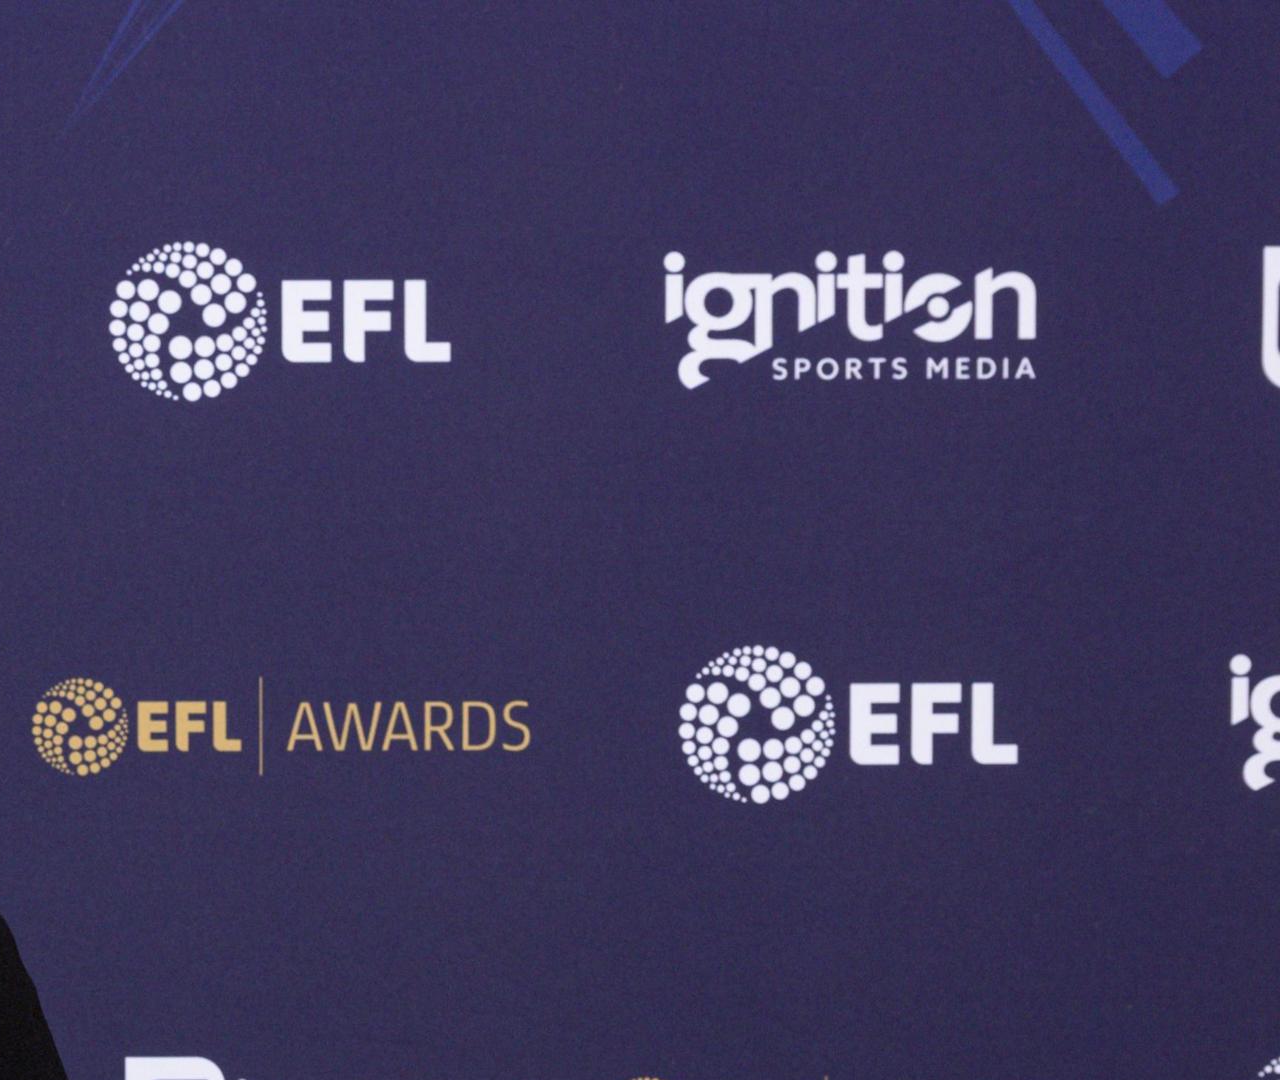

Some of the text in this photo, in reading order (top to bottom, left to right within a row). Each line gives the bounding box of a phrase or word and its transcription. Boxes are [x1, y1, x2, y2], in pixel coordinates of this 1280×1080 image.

[281, 279, 451, 363] EFL
[663, 250, 1037, 390] ignition
[772, 357, 1035, 381] SPORTS MEDIA
[136, 700, 531, 753] EFL AWARDS
[849, 682, 1018, 766] EFL
